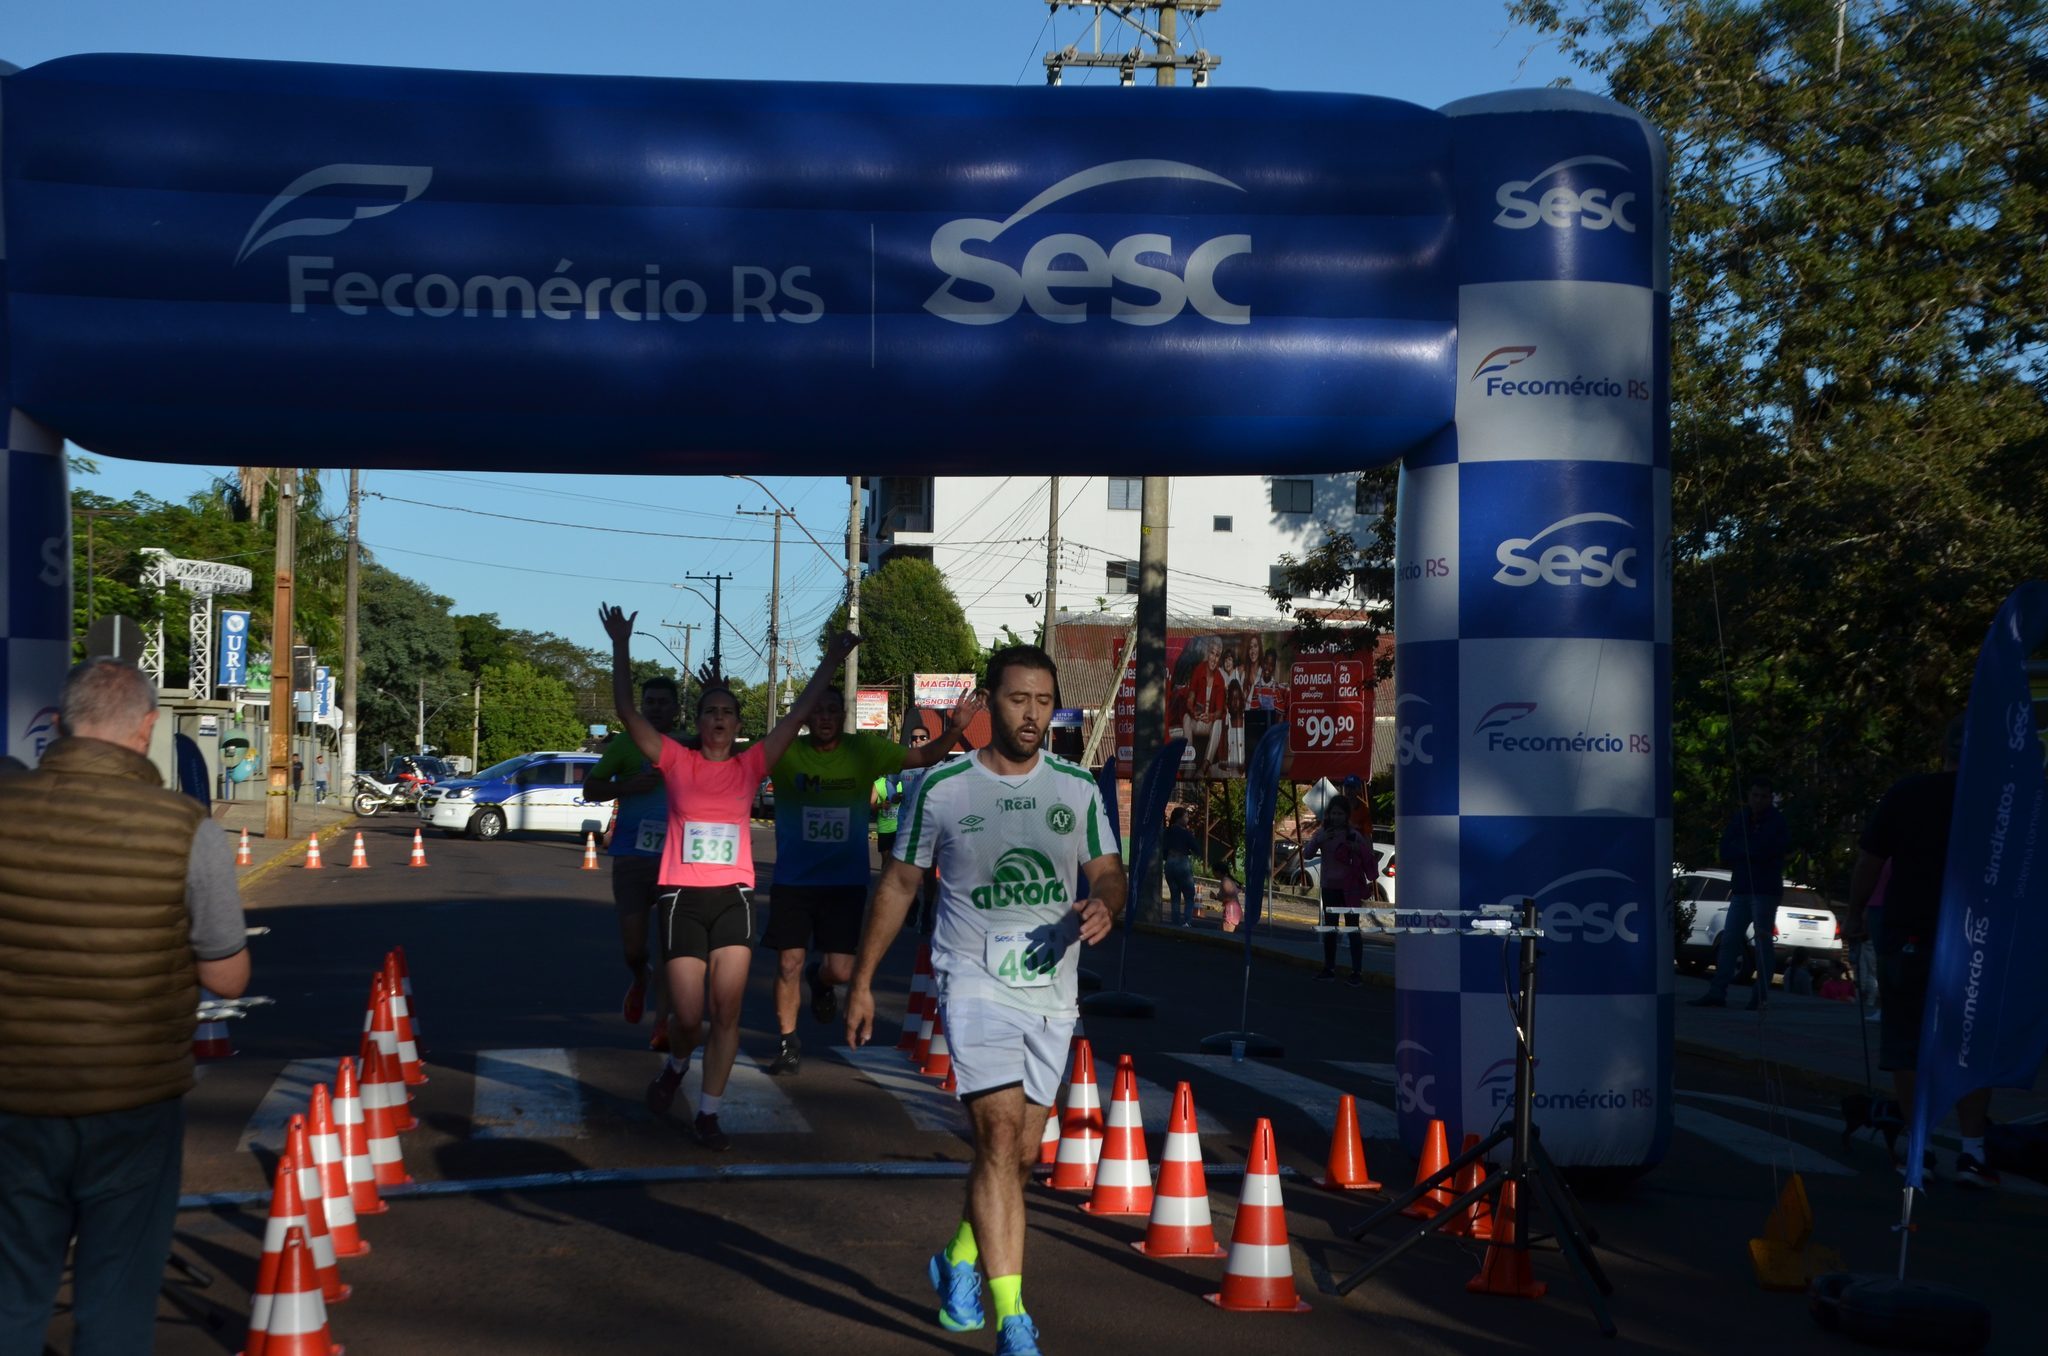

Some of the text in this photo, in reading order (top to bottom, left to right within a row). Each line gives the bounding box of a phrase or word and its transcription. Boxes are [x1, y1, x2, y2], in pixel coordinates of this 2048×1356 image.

[1493, 180, 1636, 233] Sesc
[922, 218, 1252, 326] Sesc
[288, 255, 825, 324] Fecomércio RS
[1487, 376, 1649, 400] Fecomércio RS
[1426, 557, 1450, 578] RS
[1492, 538, 1637, 588] Sesc
[225, 635, 242, 683] URI
[1294, 674, 1332, 685] 600 MEGA
[1340, 673, 1350, 684] 60
[1489, 731, 1651, 753] Fecomércio RS
[1004, 797, 1036, 811] Real
[808, 821, 843, 840] 546
[691, 839, 732, 862] 538
[971, 881, 1068, 909] aurora
[1958, 782, 2016, 1069] Fecomércio RS Sindicatos
[1491, 1088, 1626, 1109] Feomércio
